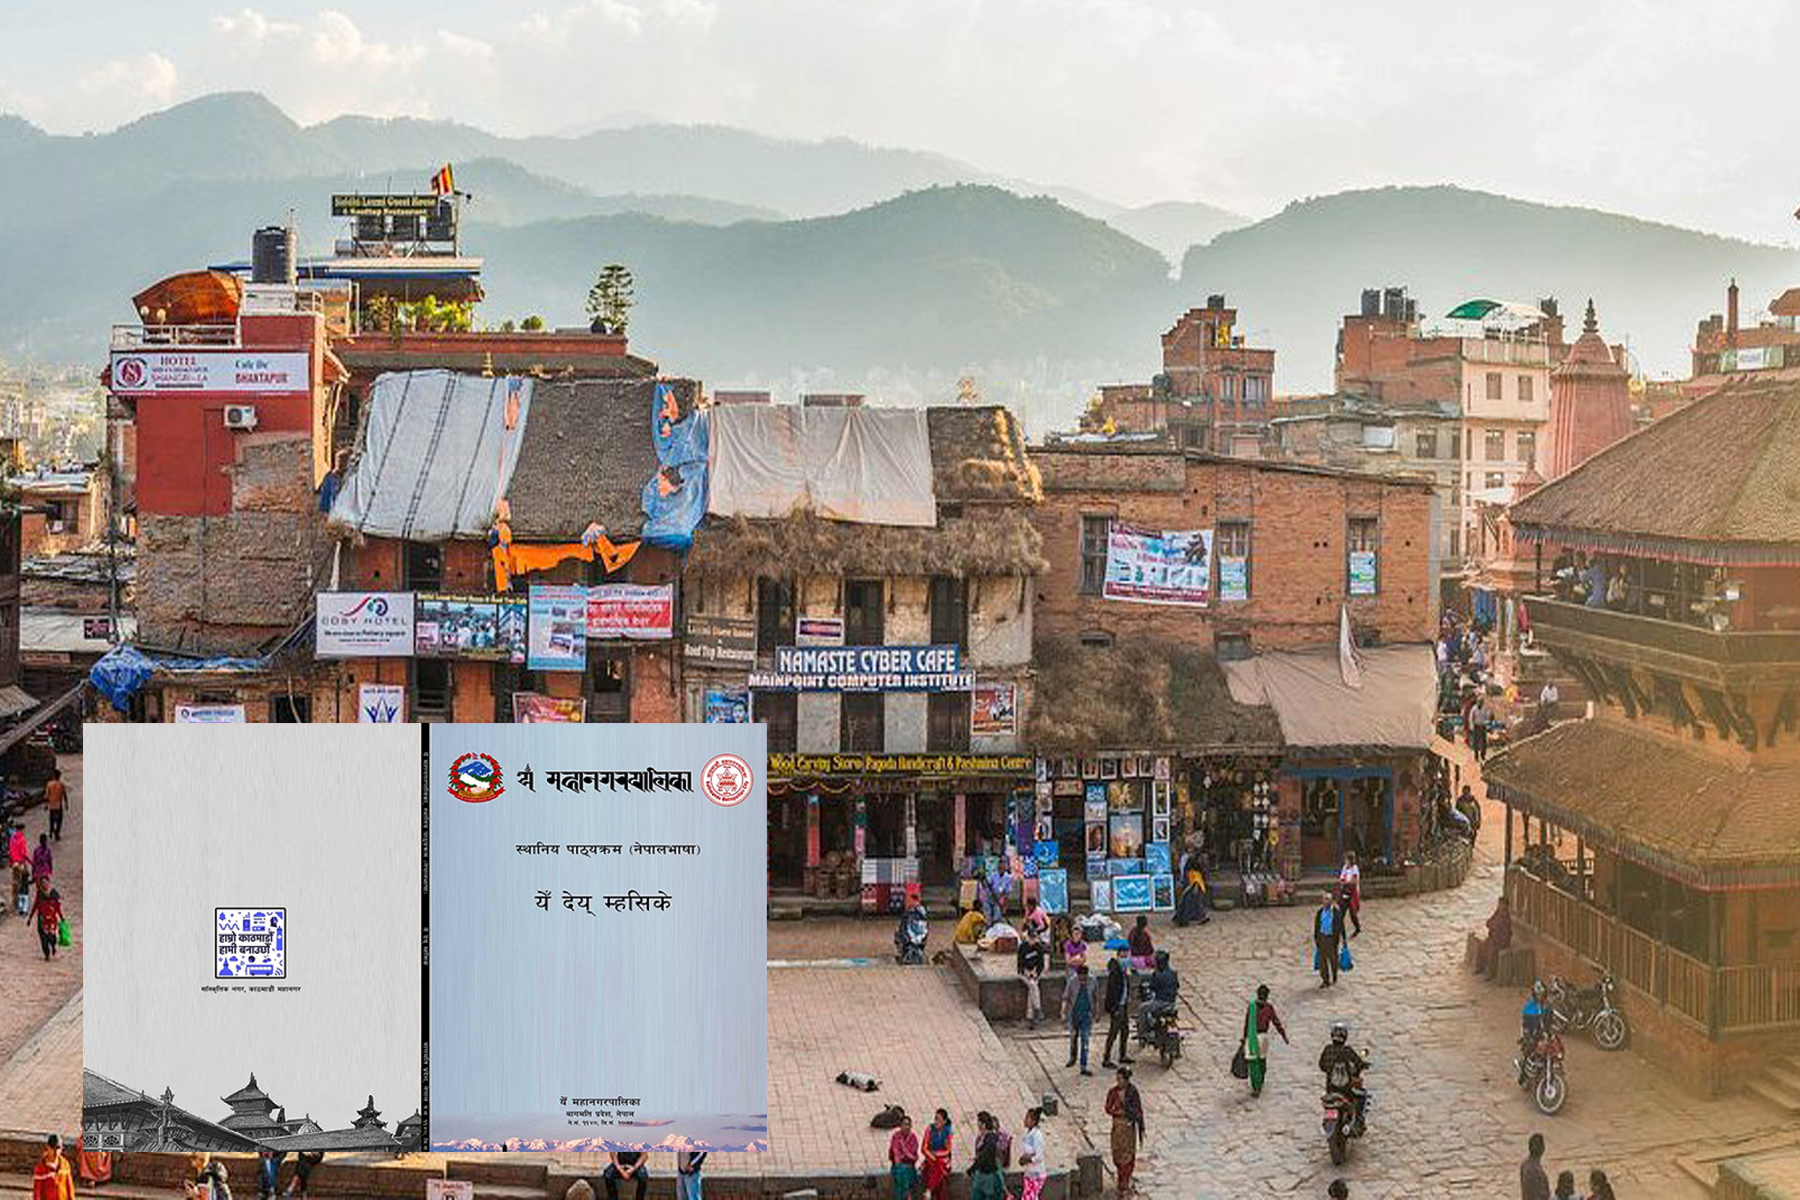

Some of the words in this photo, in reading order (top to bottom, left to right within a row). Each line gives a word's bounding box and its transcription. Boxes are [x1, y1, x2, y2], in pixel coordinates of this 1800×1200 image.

[160, 355, 196, 366] HOTEL
[363, 616, 407, 626] HOTEL
[780, 650, 856, 672] NAMASTE
[861, 650, 912, 672] CYBER
[916, 649, 956, 672] CAFE
[748, 673, 825, 687] MAINPOINT
[827, 673, 902, 688] COMPUTER
